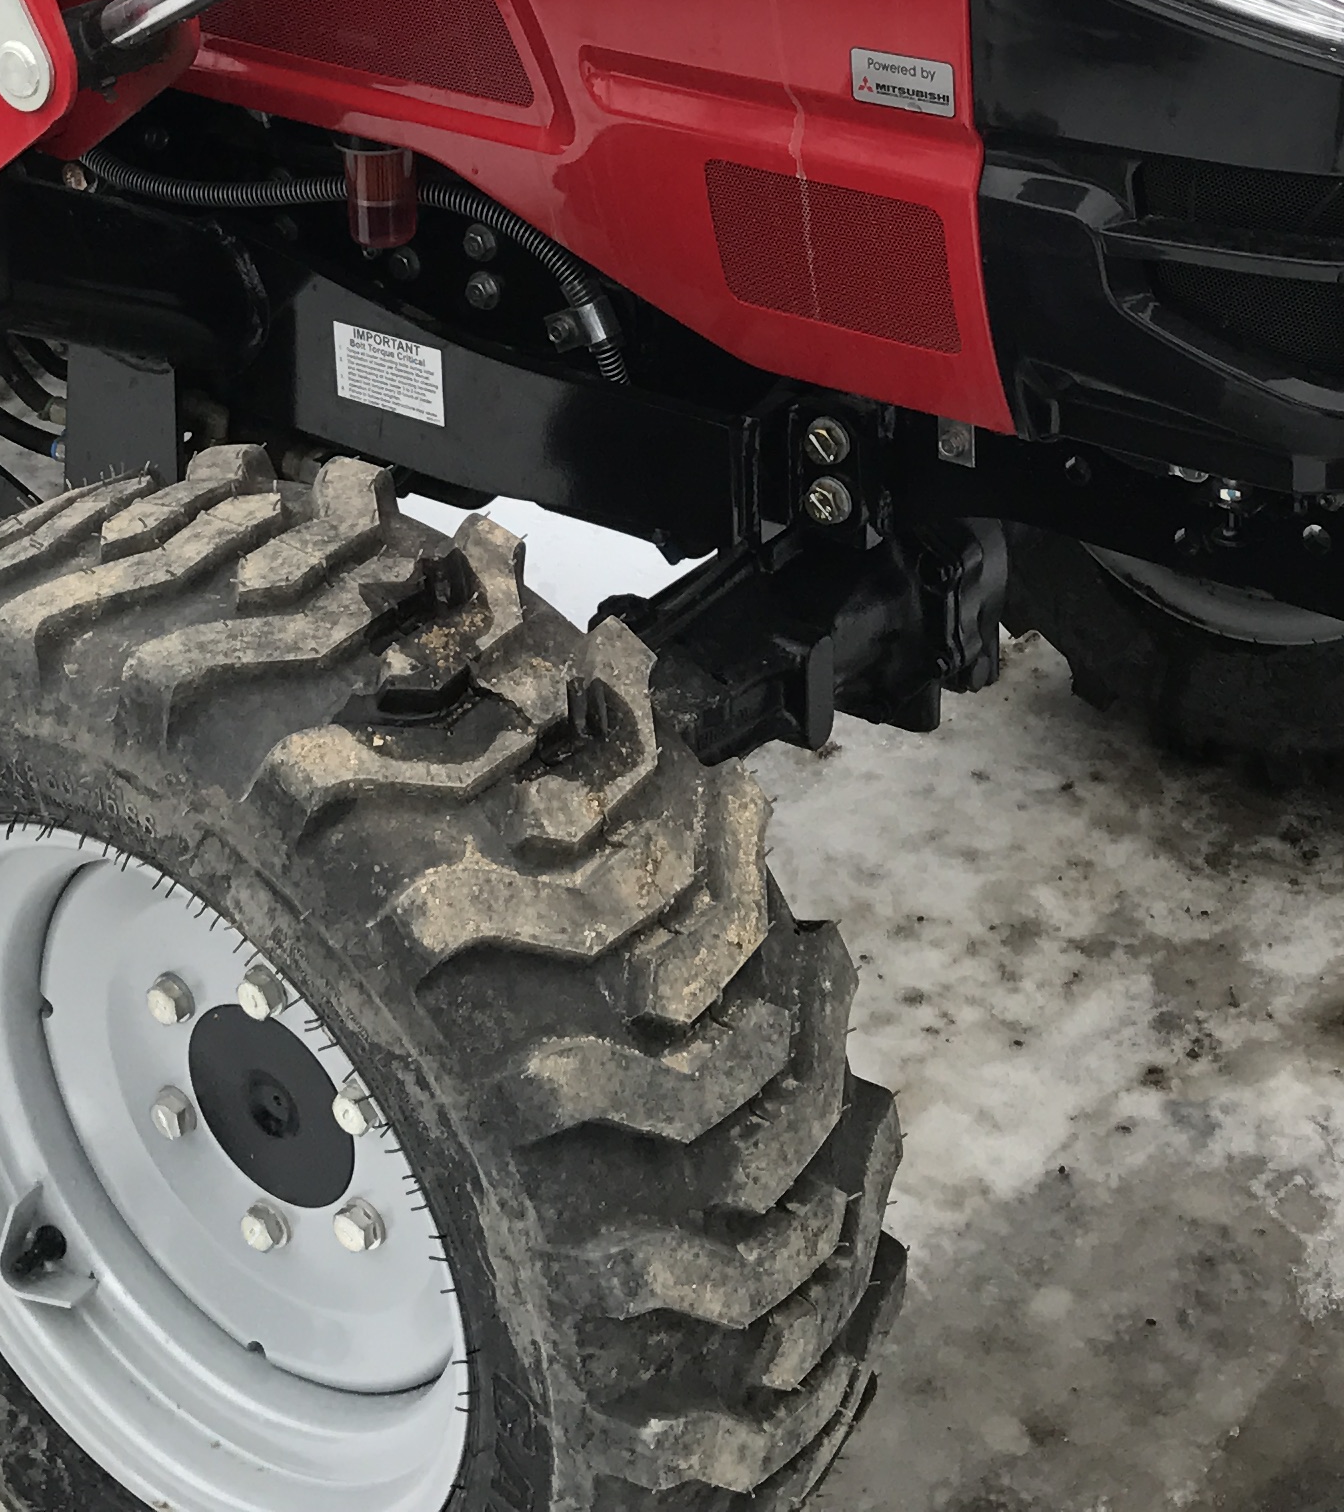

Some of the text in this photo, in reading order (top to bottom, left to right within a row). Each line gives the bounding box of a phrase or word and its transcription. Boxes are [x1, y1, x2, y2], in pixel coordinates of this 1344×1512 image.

[867, 57, 937, 83] Powered by
[875, 82, 950, 103] MITSUBISHI
[349, 338, 426, 368] Bolt Torque Critical
[353, 328, 420, 356] IMPORTANT
